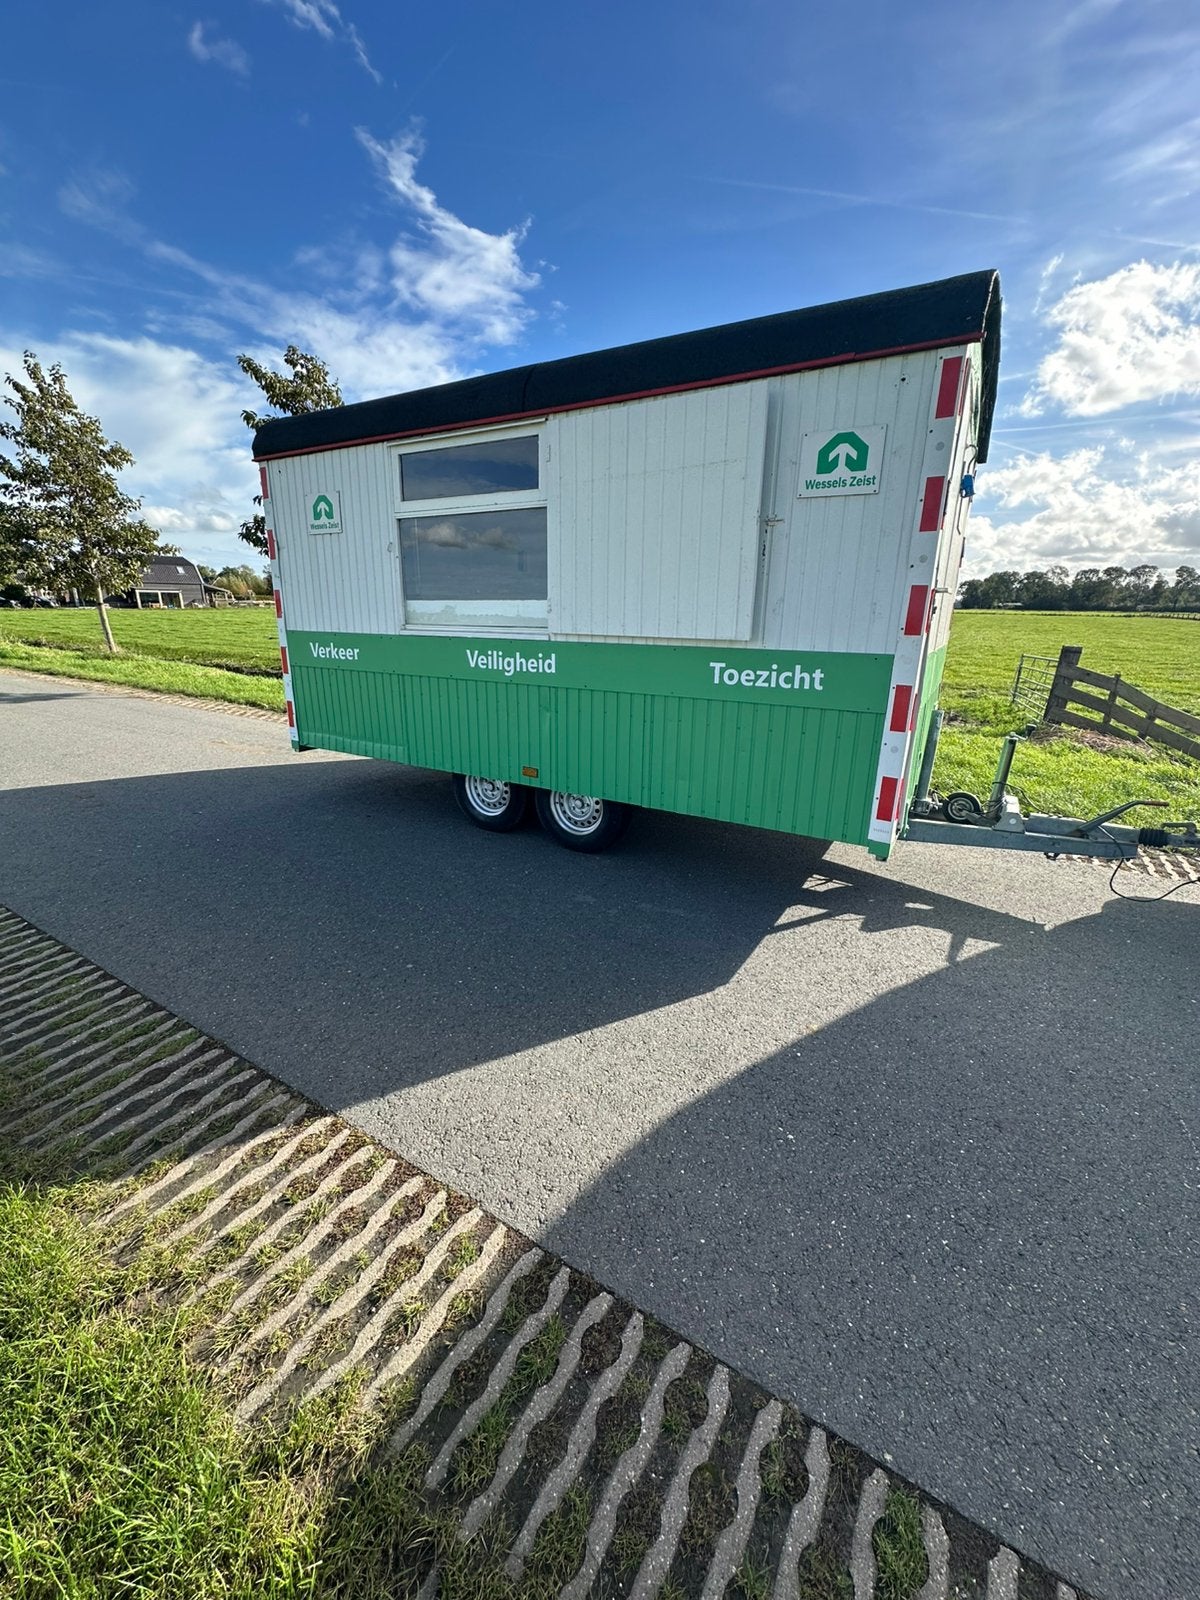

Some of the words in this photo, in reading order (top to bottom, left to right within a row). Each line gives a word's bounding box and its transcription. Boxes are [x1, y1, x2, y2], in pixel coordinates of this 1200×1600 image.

[805, 477, 847, 490] Wessels
[849, 475, 876, 487] Zeist
[309, 641, 360, 660] Verkeer
[466, 649, 556, 676] Veiligheid
[709, 661, 825, 691] Toezicht
